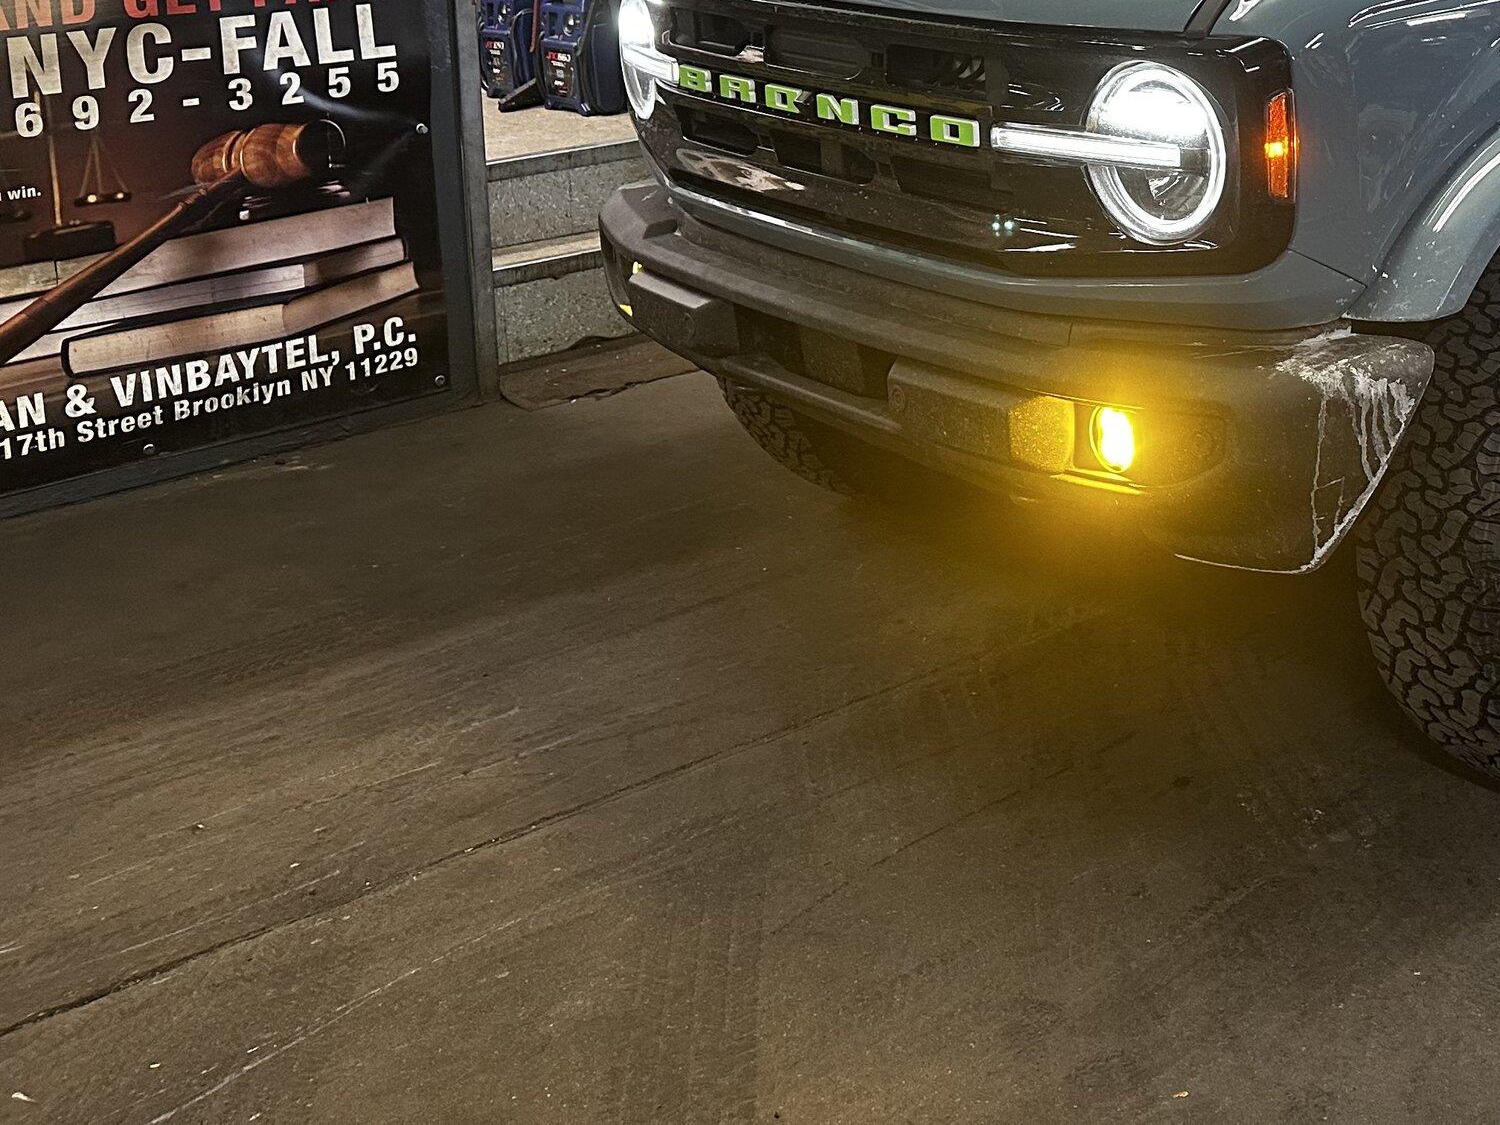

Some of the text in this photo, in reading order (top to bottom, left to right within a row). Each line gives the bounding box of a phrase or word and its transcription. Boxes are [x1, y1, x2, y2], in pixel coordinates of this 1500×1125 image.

[6, 3, 397, 100] NYC-FALL
[680, 64, 981, 147] BRONCO
[7, 185, 42, 200] win.
[65, 384, 97, 418] &
[110, 334, 340, 408] VINBAYTEL,
[353, 316, 417, 355] P.C.
[76, 405, 164, 443] Street
[301, 365, 334, 392] NY
[345, 347, 419, 381] 11229
